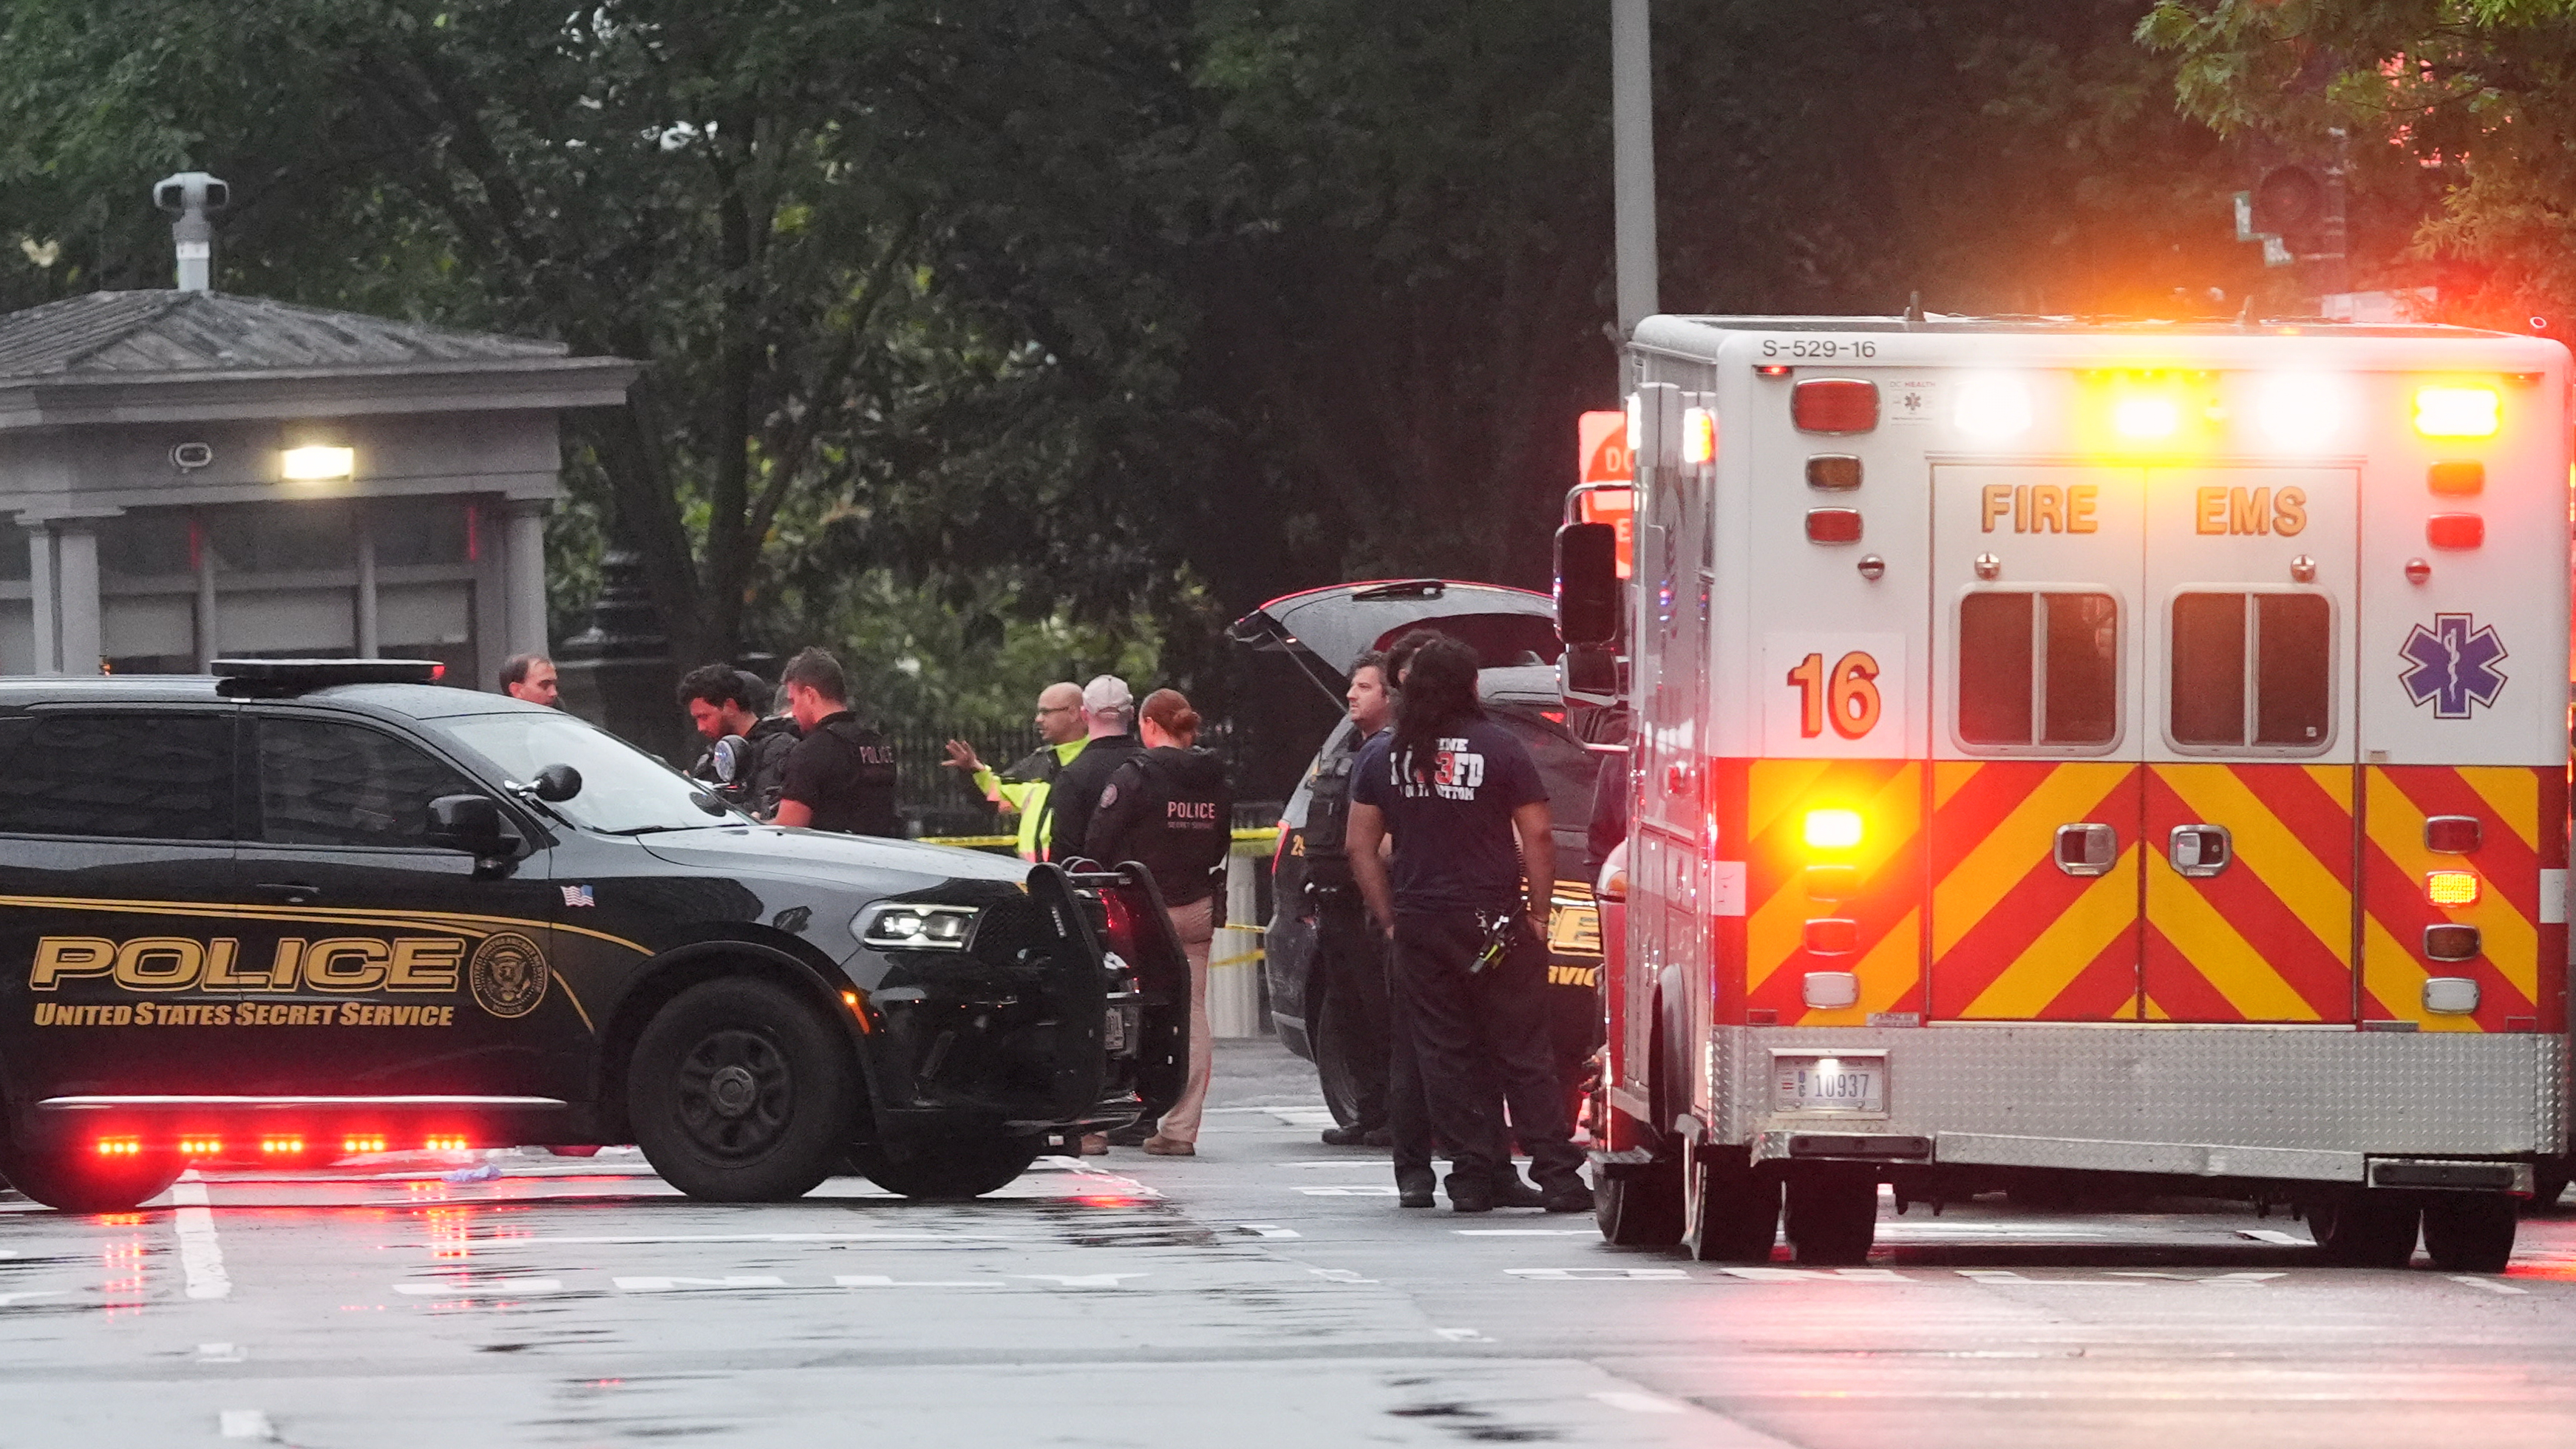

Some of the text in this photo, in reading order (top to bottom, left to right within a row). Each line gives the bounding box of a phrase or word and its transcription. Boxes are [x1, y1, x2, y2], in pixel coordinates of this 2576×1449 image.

[1762, 339, 1876, 358] S-529-16
[1981, 484, 2098, 534] FIRE
[2196, 486, 2307, 537] EMS
[1787, 651, 1881, 741] 16
[859, 746, 894, 764] POLICE
[1167, 801, 1216, 819] POLICE
[29, 936, 467, 992] POLICE
[33, 1002, 455, 1026] UNITED STATES SECRET SERVICE
[1815, 1074, 1869, 1098] 10937
